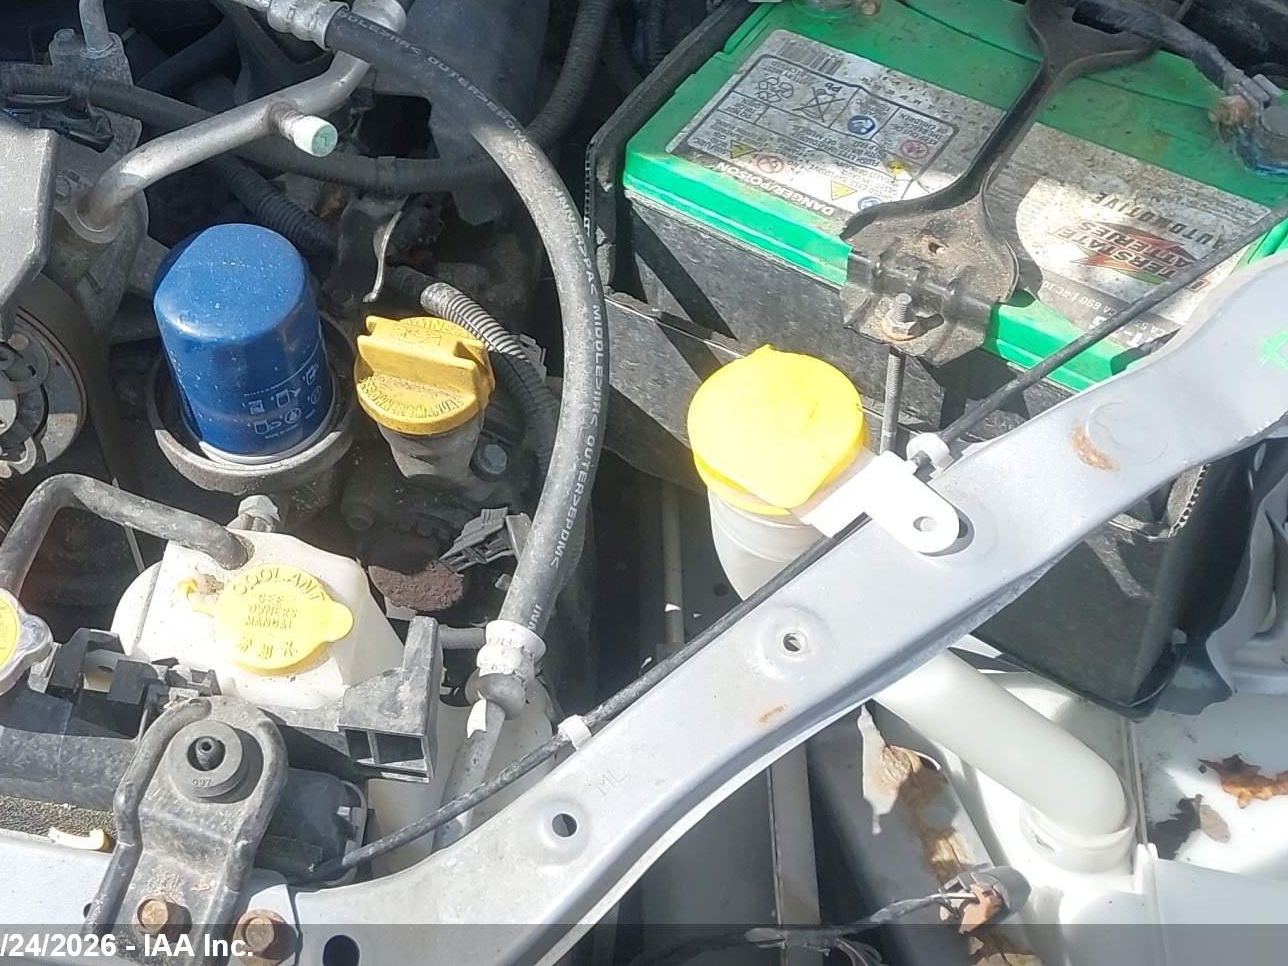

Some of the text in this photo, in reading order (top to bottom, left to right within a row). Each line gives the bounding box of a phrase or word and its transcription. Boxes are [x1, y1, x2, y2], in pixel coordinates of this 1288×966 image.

[821, 81, 843, 93] Pb
[712, 160, 837, 216] DANGER/POISON
[1091, 191, 1223, 250] AUTOMOTIVE
[1053, 227, 1209, 291] ITERSTATE
[1080, 221, 1192, 271] ATTERIES
[1078, 295, 1103, 309] 690
[231, 566, 326, 603] COOLANT
